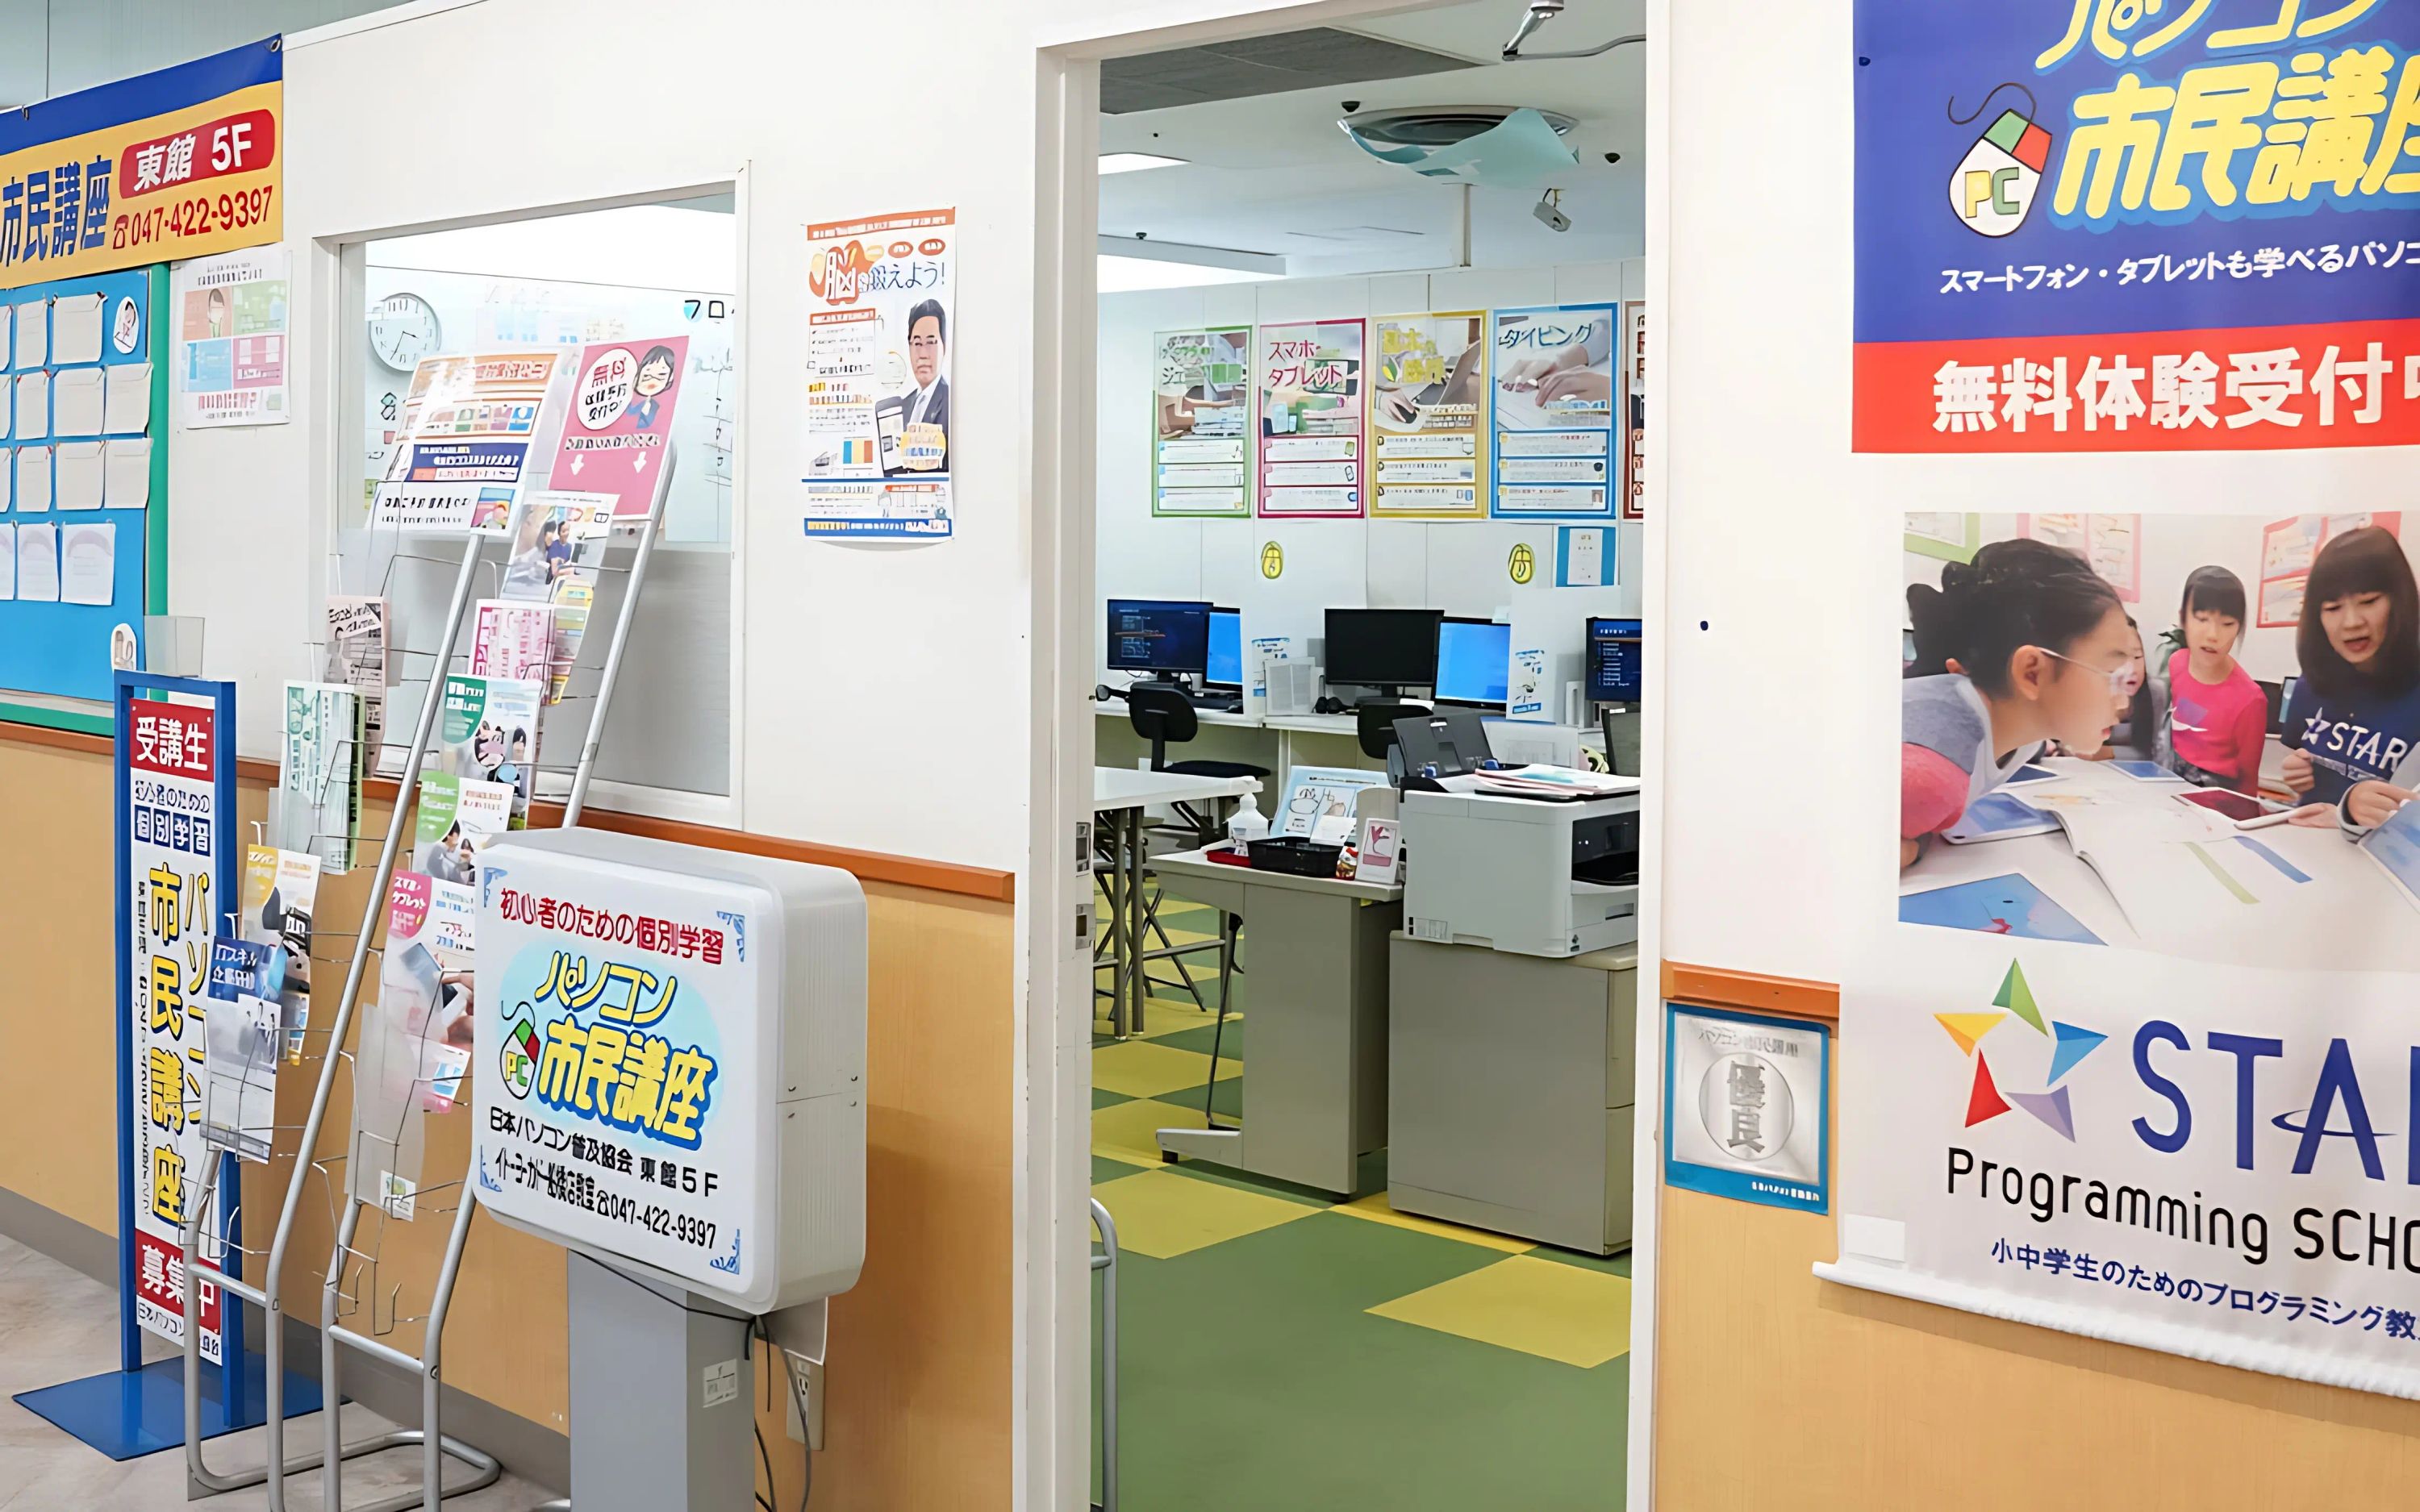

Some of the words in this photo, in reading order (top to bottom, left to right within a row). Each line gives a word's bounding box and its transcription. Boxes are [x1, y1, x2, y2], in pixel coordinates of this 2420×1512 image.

[133, 134, 196, 192] 東館
[211, 123, 252, 172] 5F
[1965, 166, 2020, 219] PC
[1932, 341, 2420, 433] 無料体験受付
[136, 715, 208, 771] 受講生
[500, 888, 724, 965] 初心者のための個別学習
[534, 950, 678, 1027] パソコン
[505, 1050, 529, 1088] PC
[536, 1013, 718, 1152] 市民講座
[2131, 1019, 2420, 1186] STA
[1947, 1147, 2268, 1265] Programming
[1991, 1237, 2420, 1341] 小中学生のためのプログラミング教
